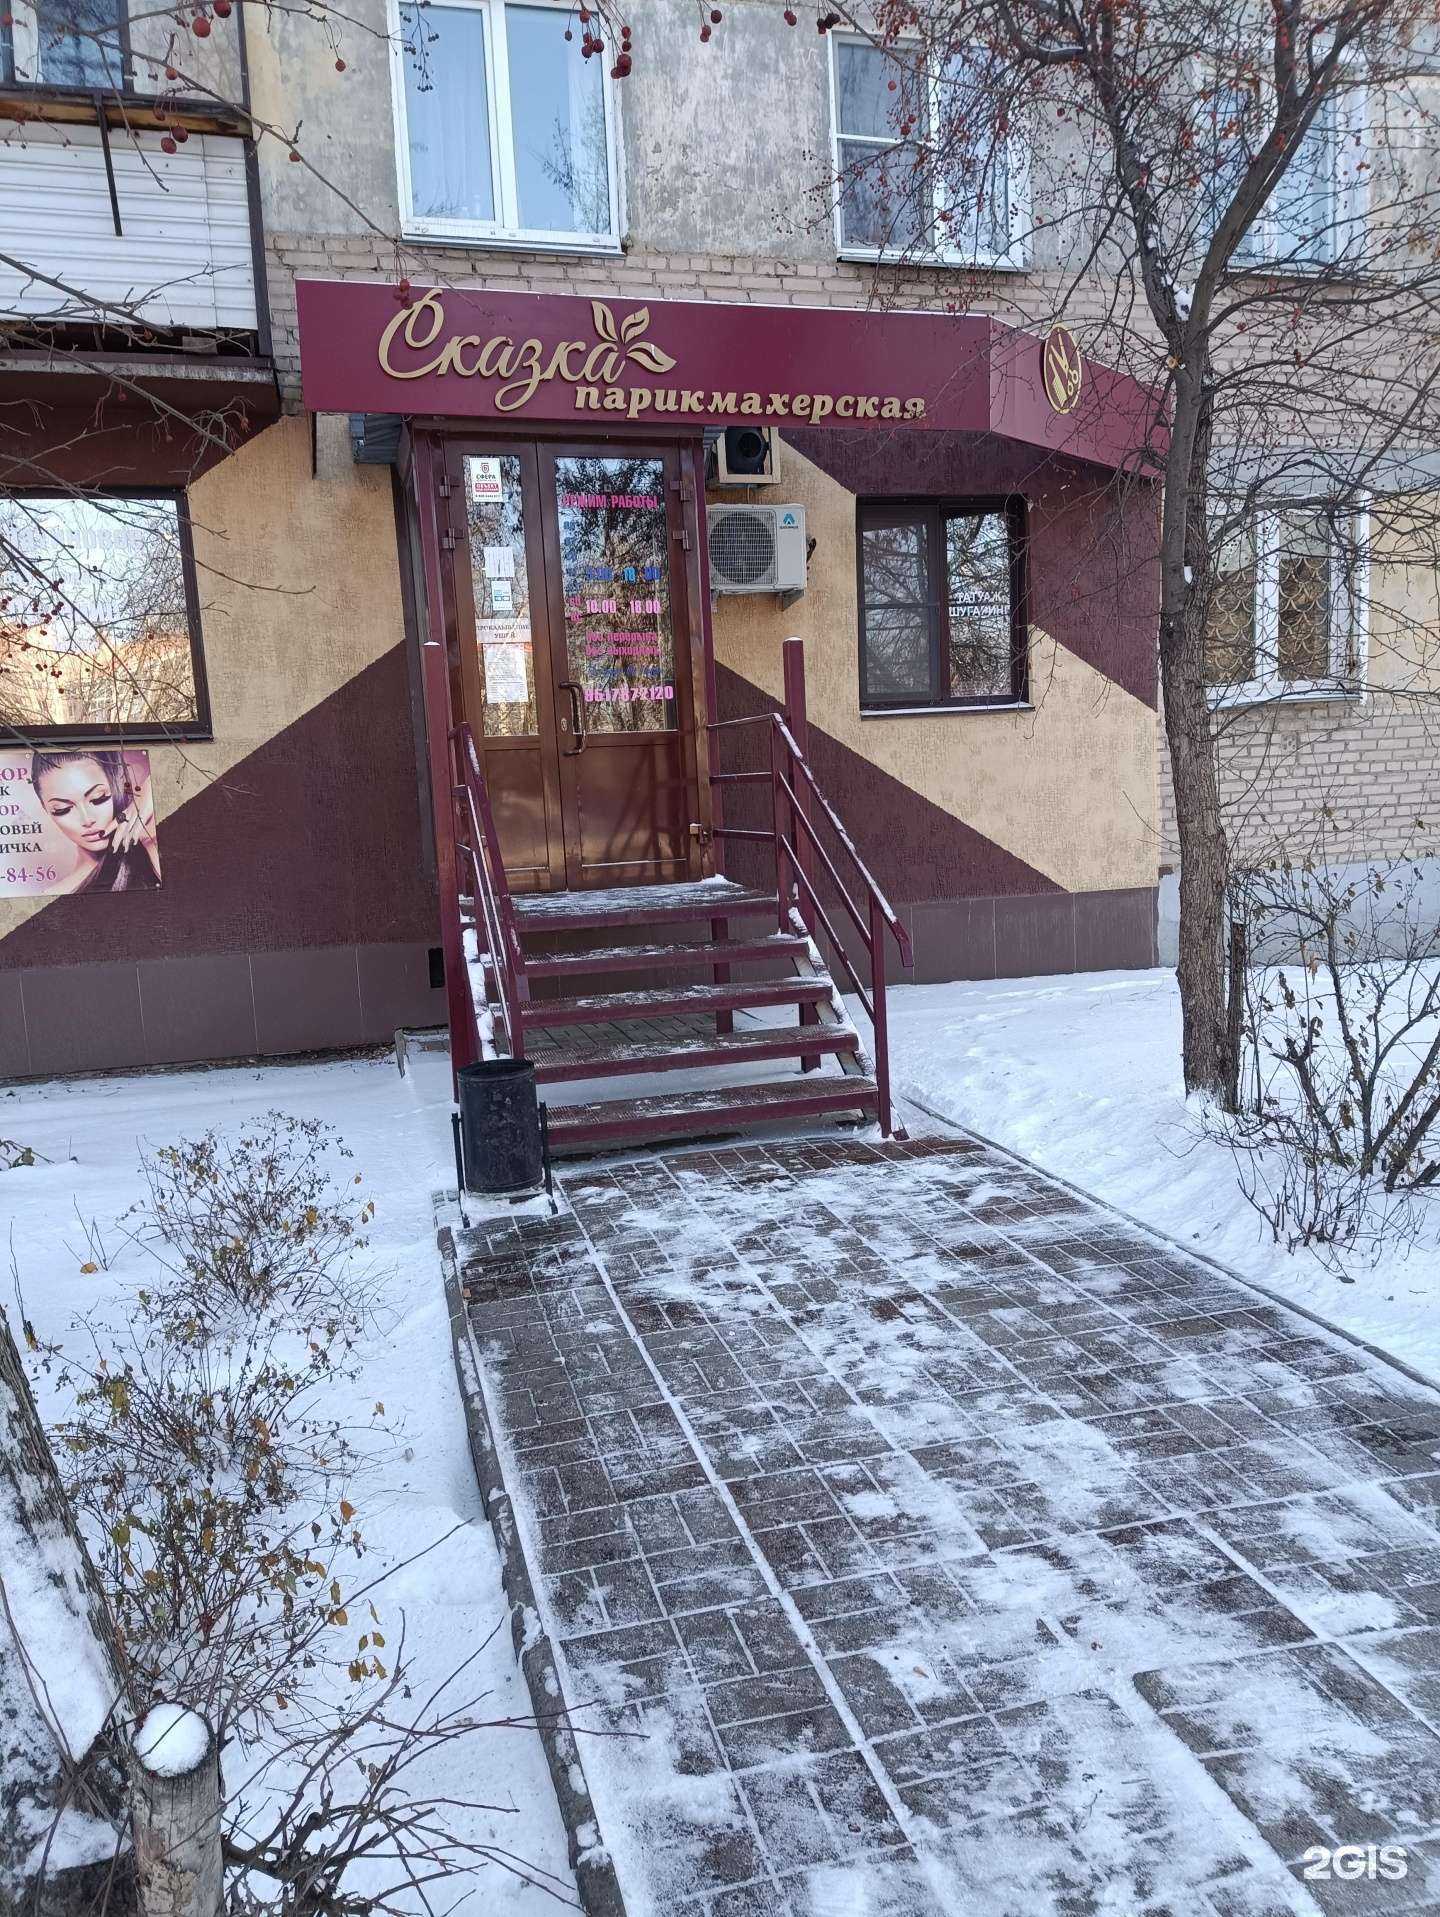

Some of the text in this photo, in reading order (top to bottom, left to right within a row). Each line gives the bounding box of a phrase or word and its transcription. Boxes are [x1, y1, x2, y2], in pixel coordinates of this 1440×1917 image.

[378, 288, 627, 412] Сказка
[574, 384, 927, 424] парикмахерская
[611, 494, 659, 509] РАБОТЫ
[957, 590, 1003, 603] ТАТУАЖ
